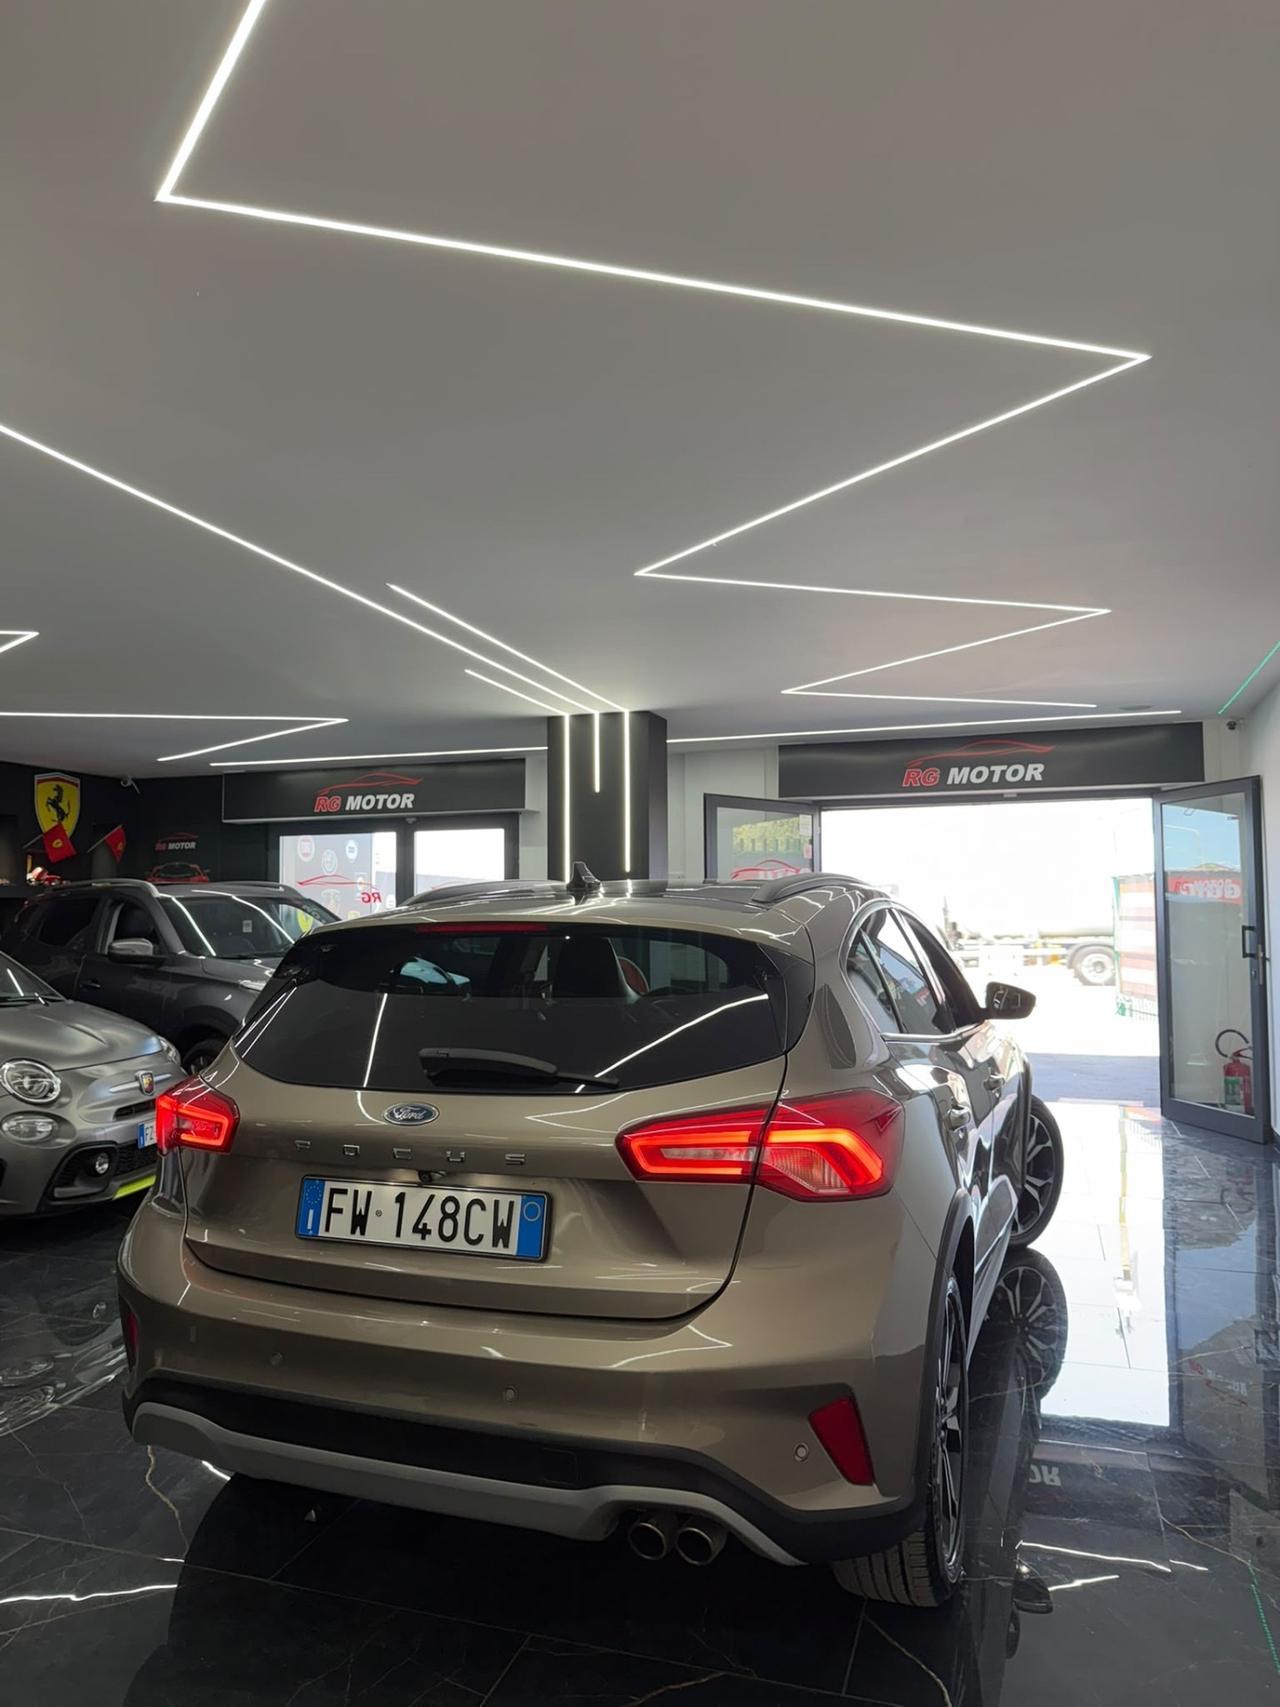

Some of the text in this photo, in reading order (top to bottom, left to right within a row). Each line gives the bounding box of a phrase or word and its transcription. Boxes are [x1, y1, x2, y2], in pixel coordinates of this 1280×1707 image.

[902, 763, 1045, 787] RG MOTOR
[314, 793, 415, 812] RG MOTOR
[168, 841, 196, 850] MOTOR
[391, 1105, 426, 1120] Ford
[325, 1188, 372, 1236] FW
[394, 1191, 515, 1248] 148CW
